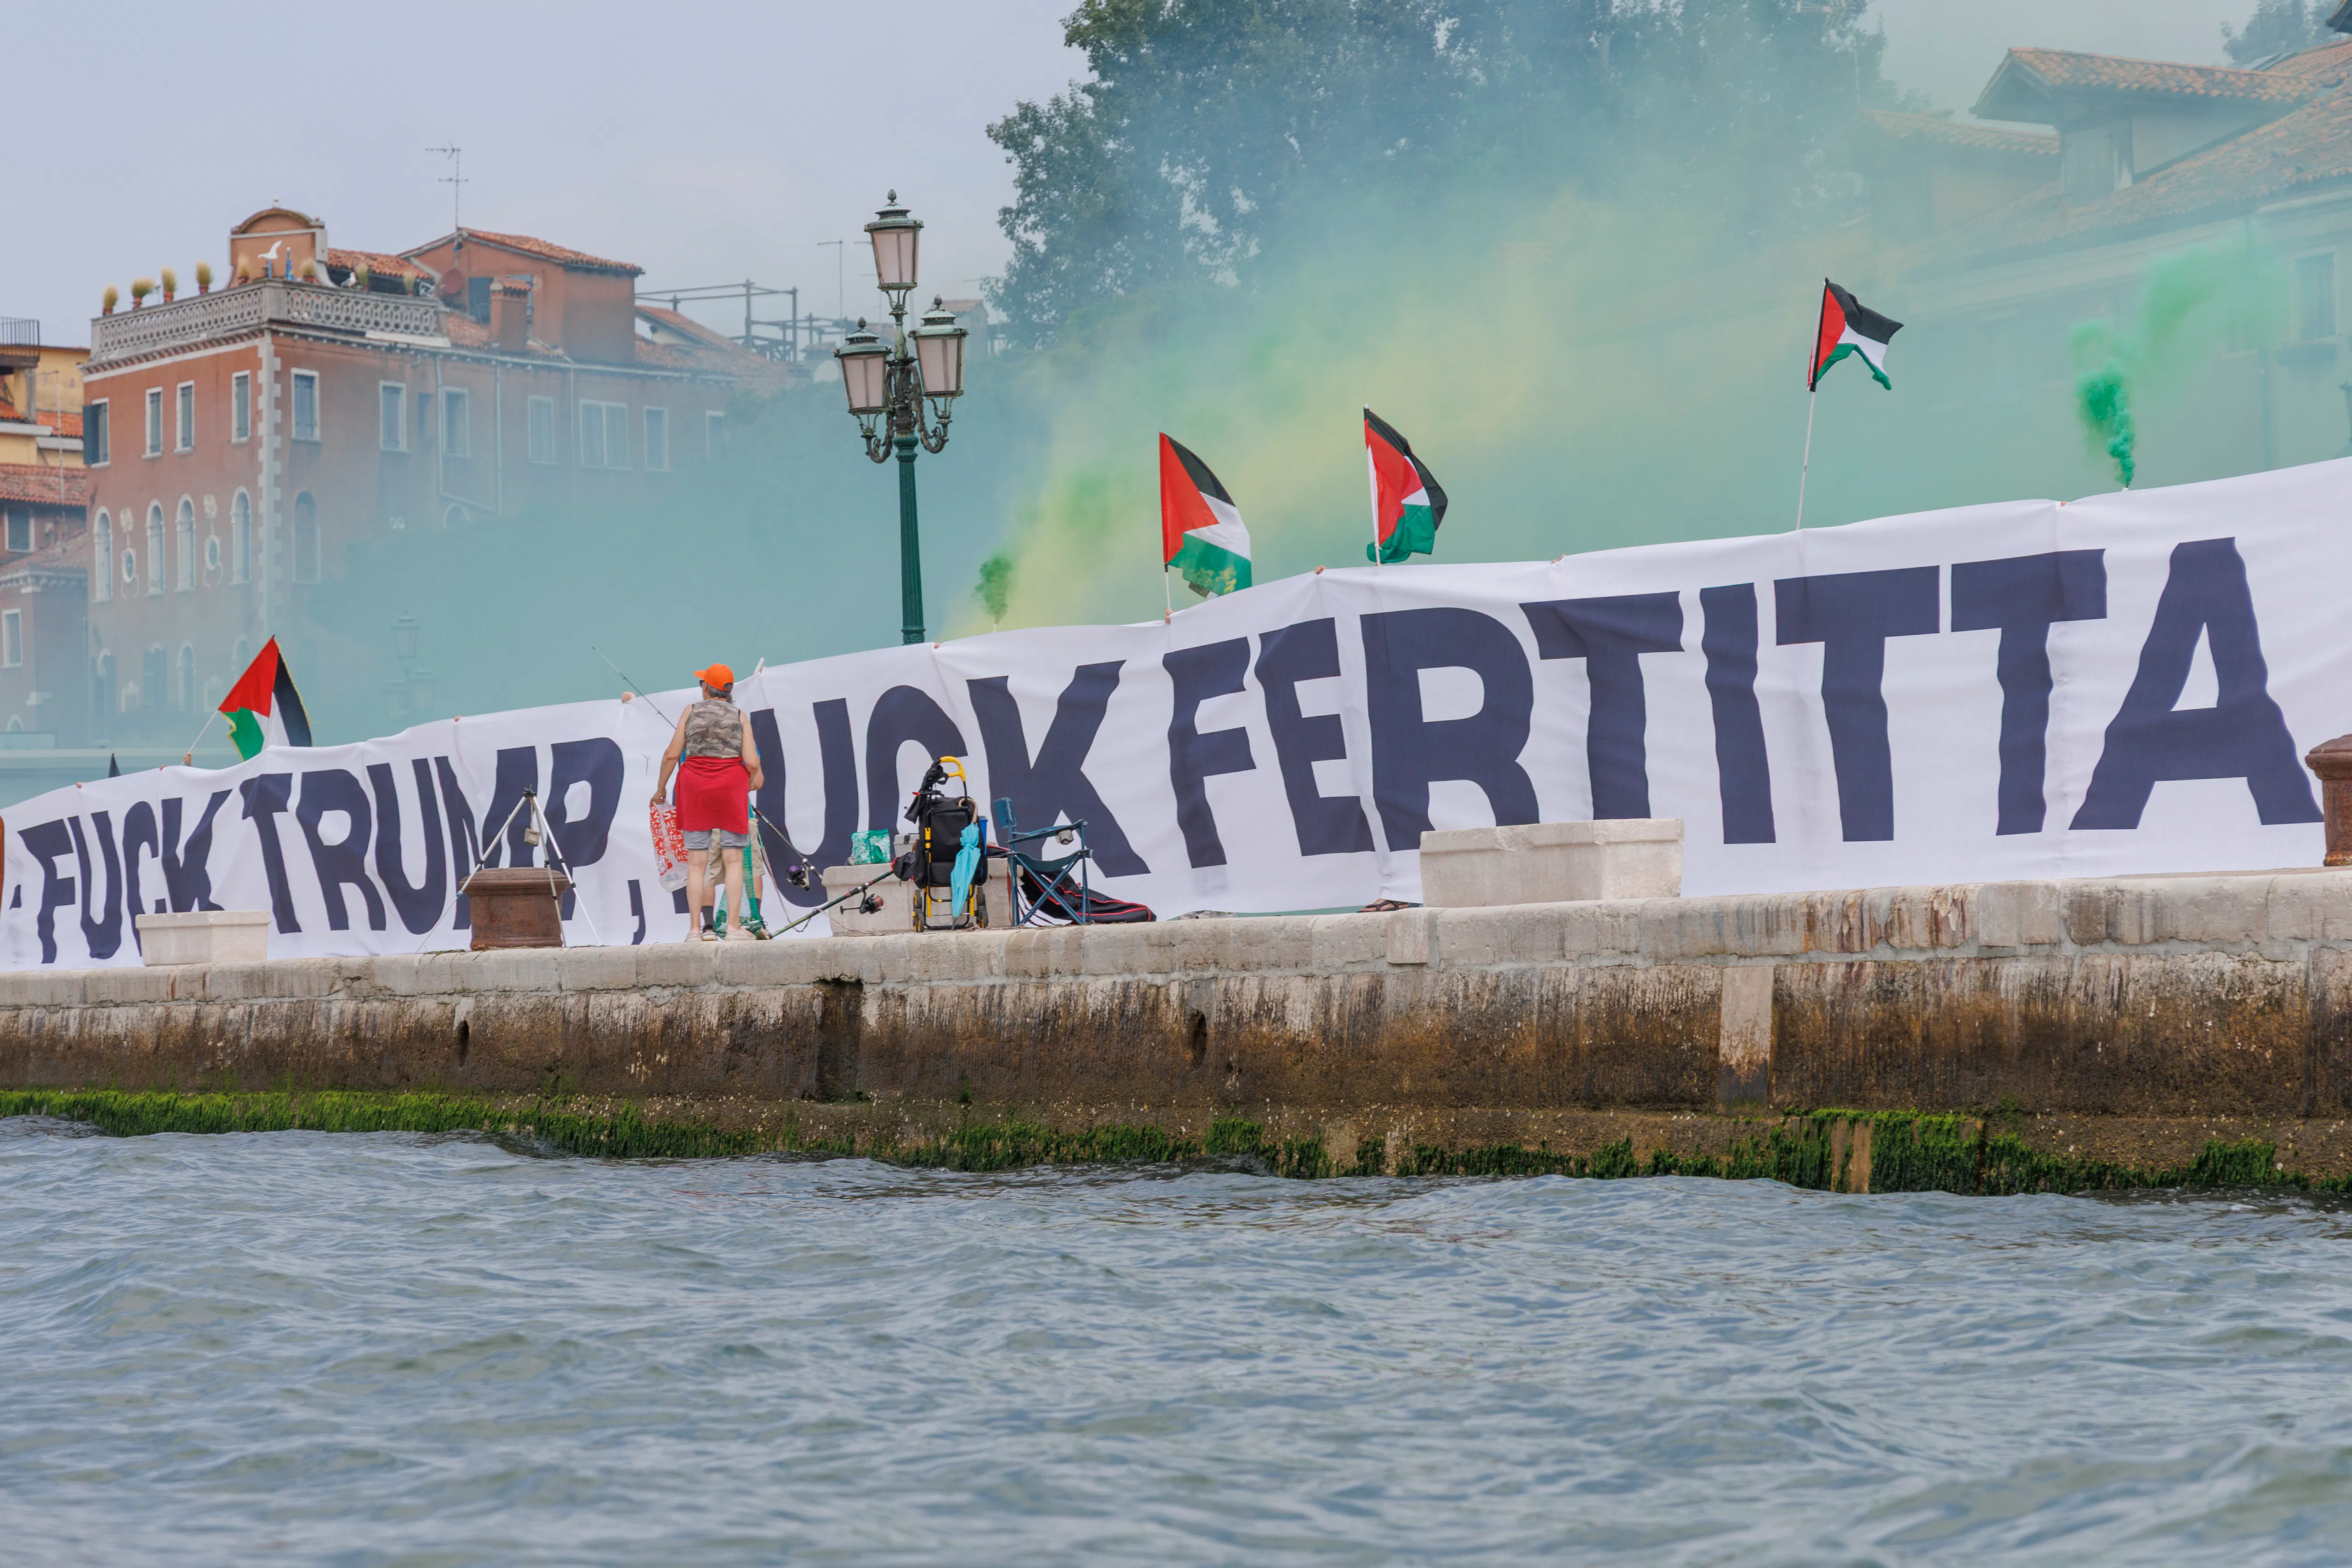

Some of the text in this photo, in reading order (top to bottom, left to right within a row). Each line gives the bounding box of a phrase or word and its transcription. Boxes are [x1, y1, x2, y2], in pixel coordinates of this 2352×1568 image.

[17, 536, 2324, 964] FUCK TRUMP, UCK FERTITTA
